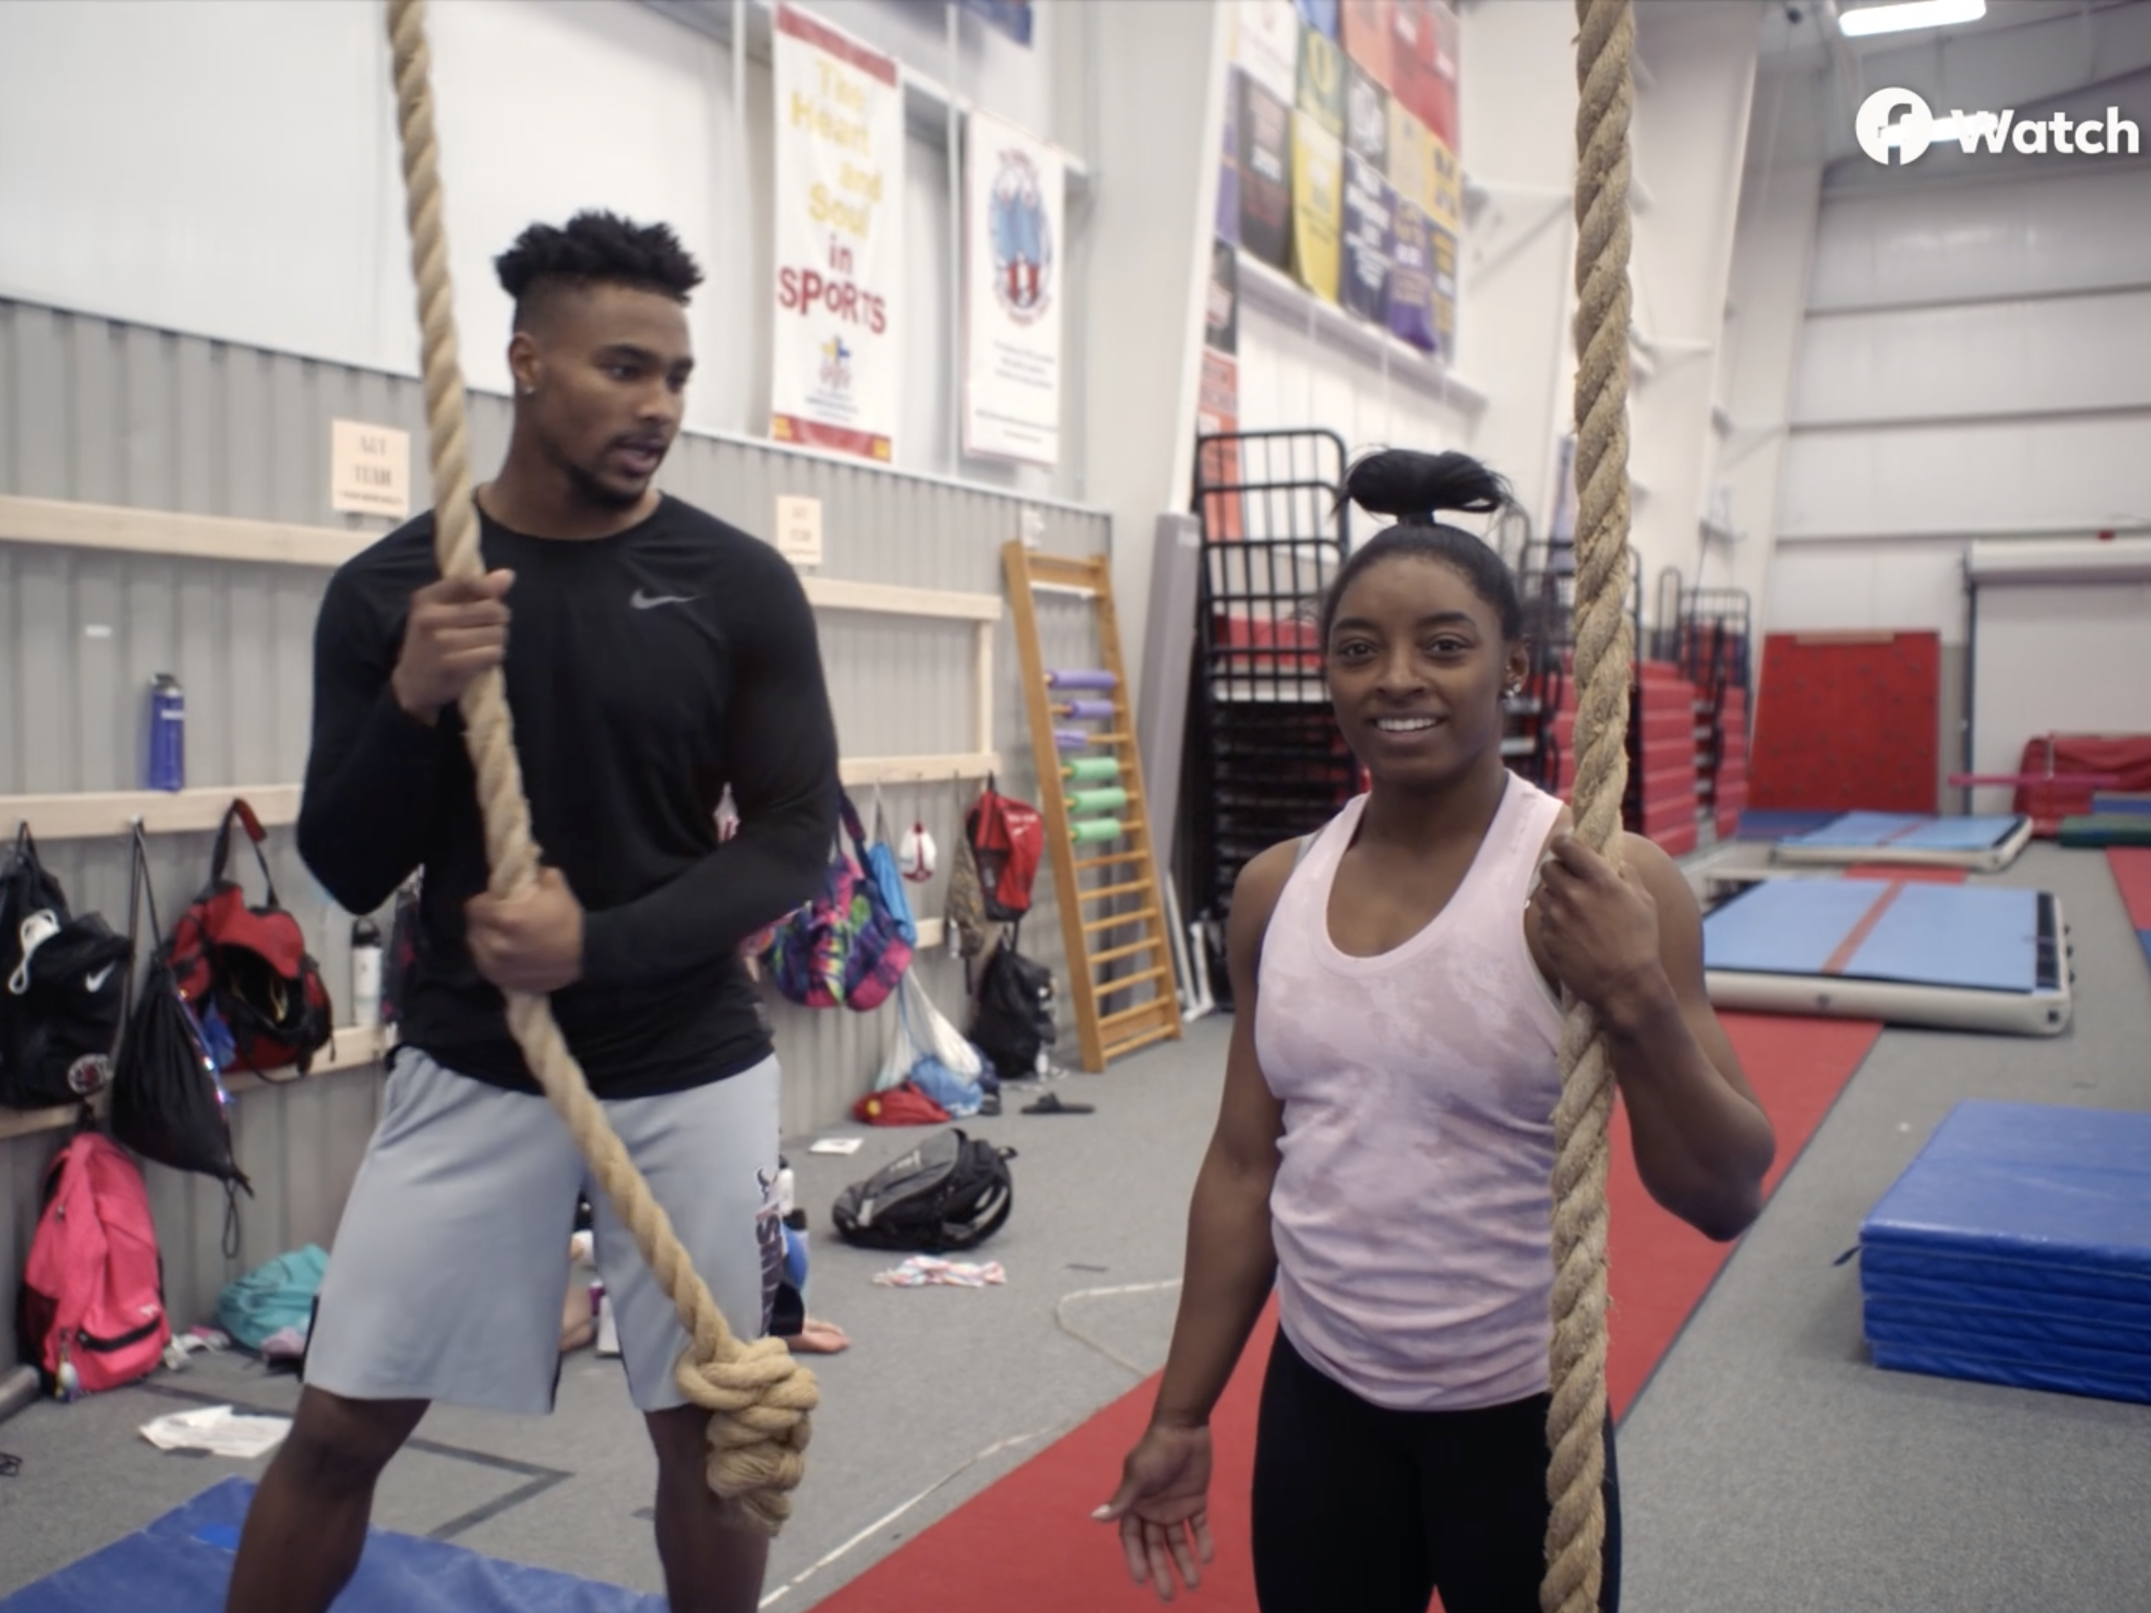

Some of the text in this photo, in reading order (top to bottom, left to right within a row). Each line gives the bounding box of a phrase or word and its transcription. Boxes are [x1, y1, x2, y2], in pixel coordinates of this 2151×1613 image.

[790, 90, 871, 157] Heart
[809, 179, 872, 240] Soul
[839, 162, 884, 204] and
[829, 233, 854, 275] in
[778, 265, 887, 336] SPORTS
